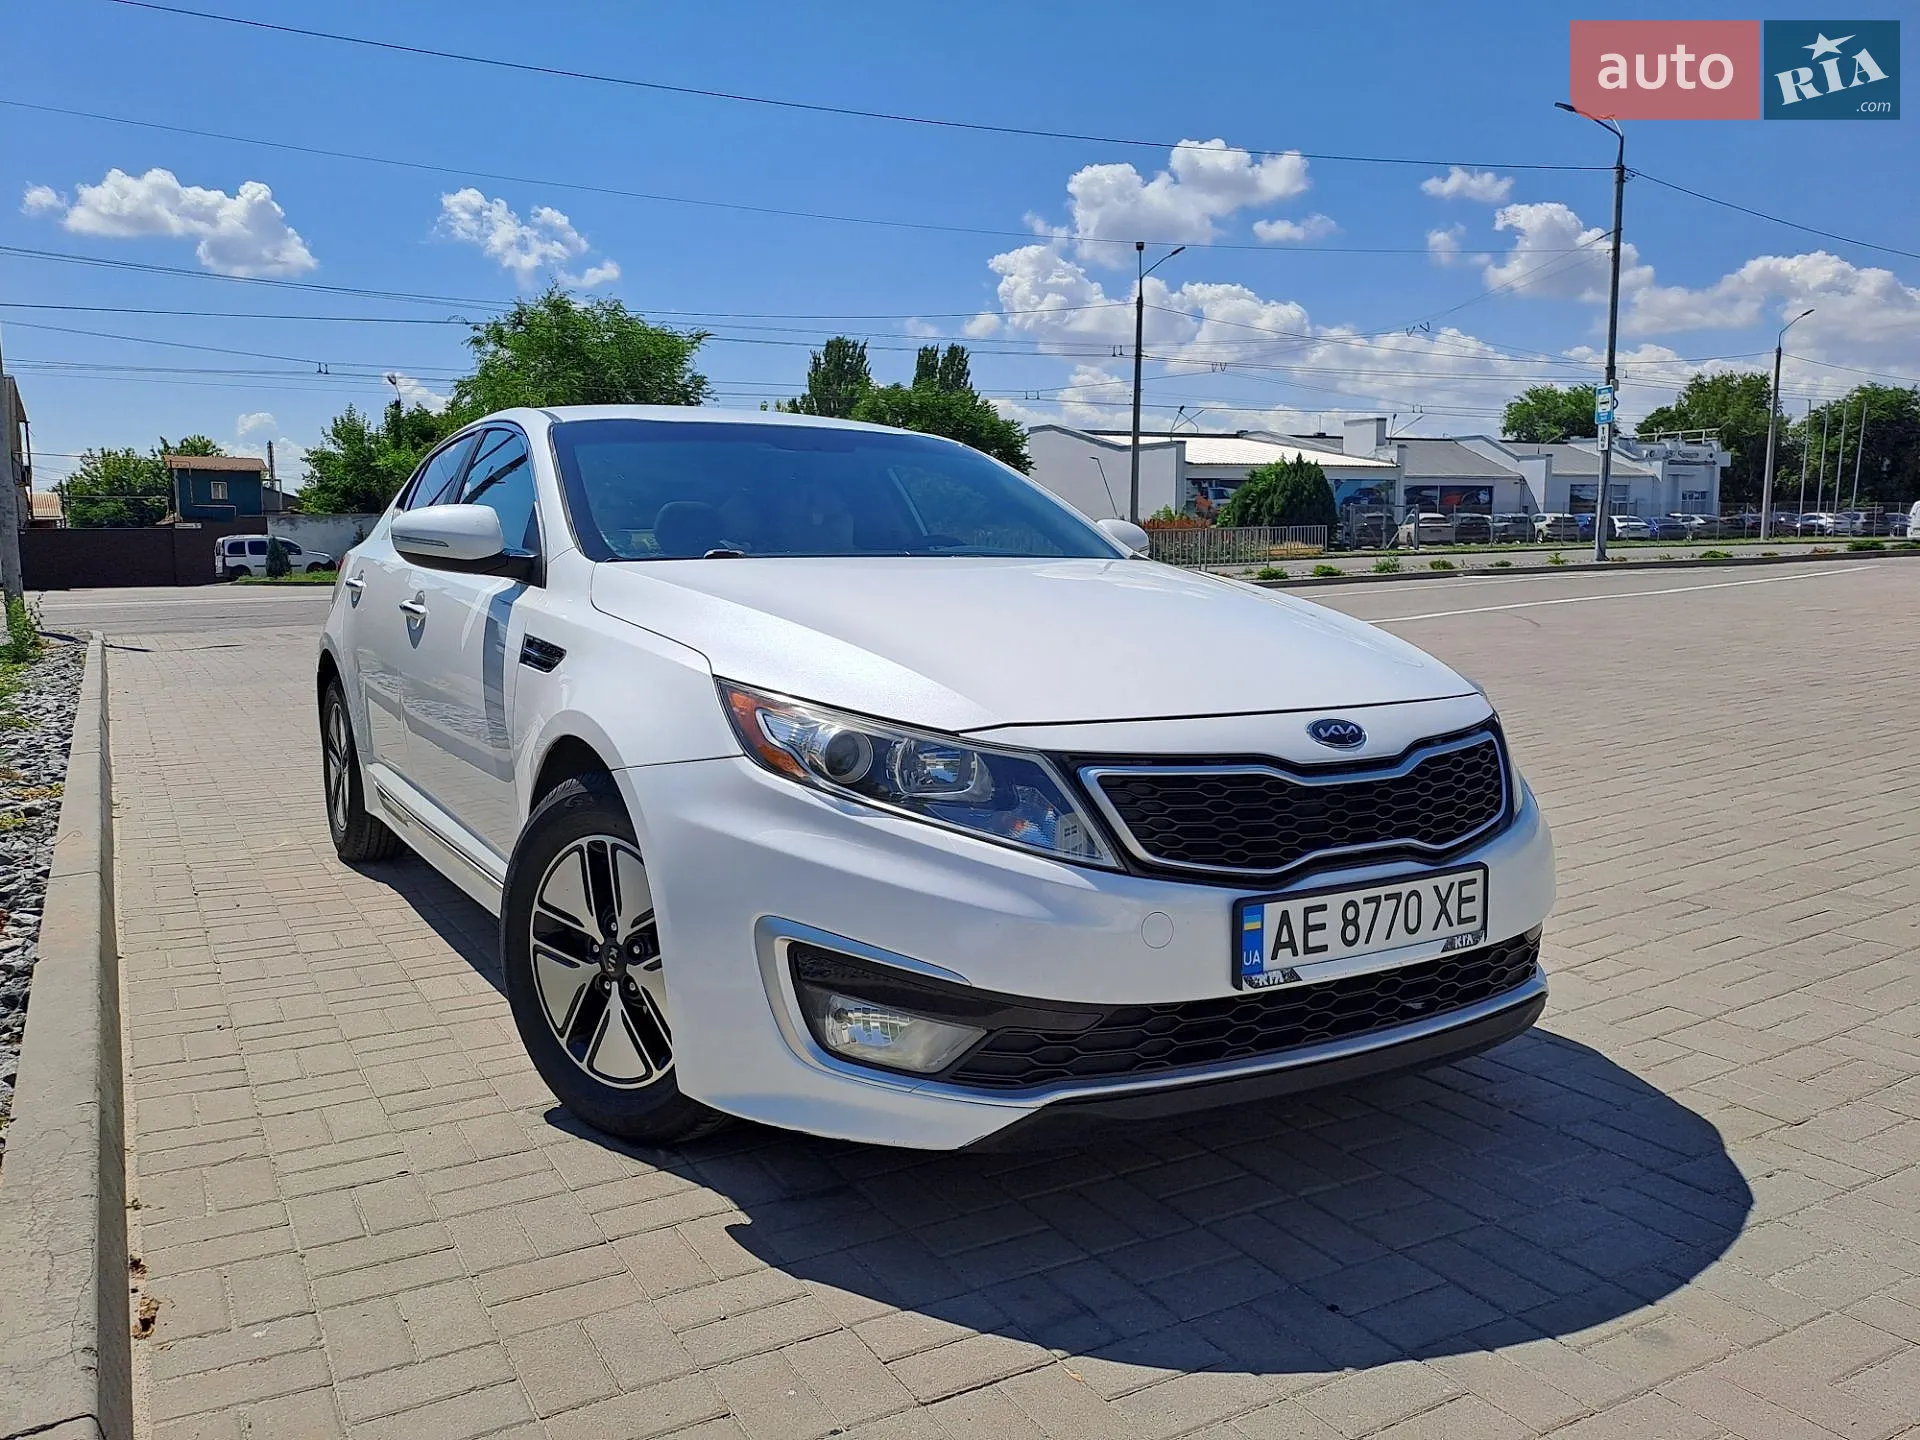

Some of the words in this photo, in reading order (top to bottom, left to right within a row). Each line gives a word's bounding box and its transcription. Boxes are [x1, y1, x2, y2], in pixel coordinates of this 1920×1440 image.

[1270, 903, 1329, 961] AE
[1340, 889, 1422, 948] 8770
[1431, 878, 1478, 931] XE
[1454, 933, 1474, 949] KIA
[608, 947, 618, 971] KIA
[1243, 949, 1261, 966] UA
